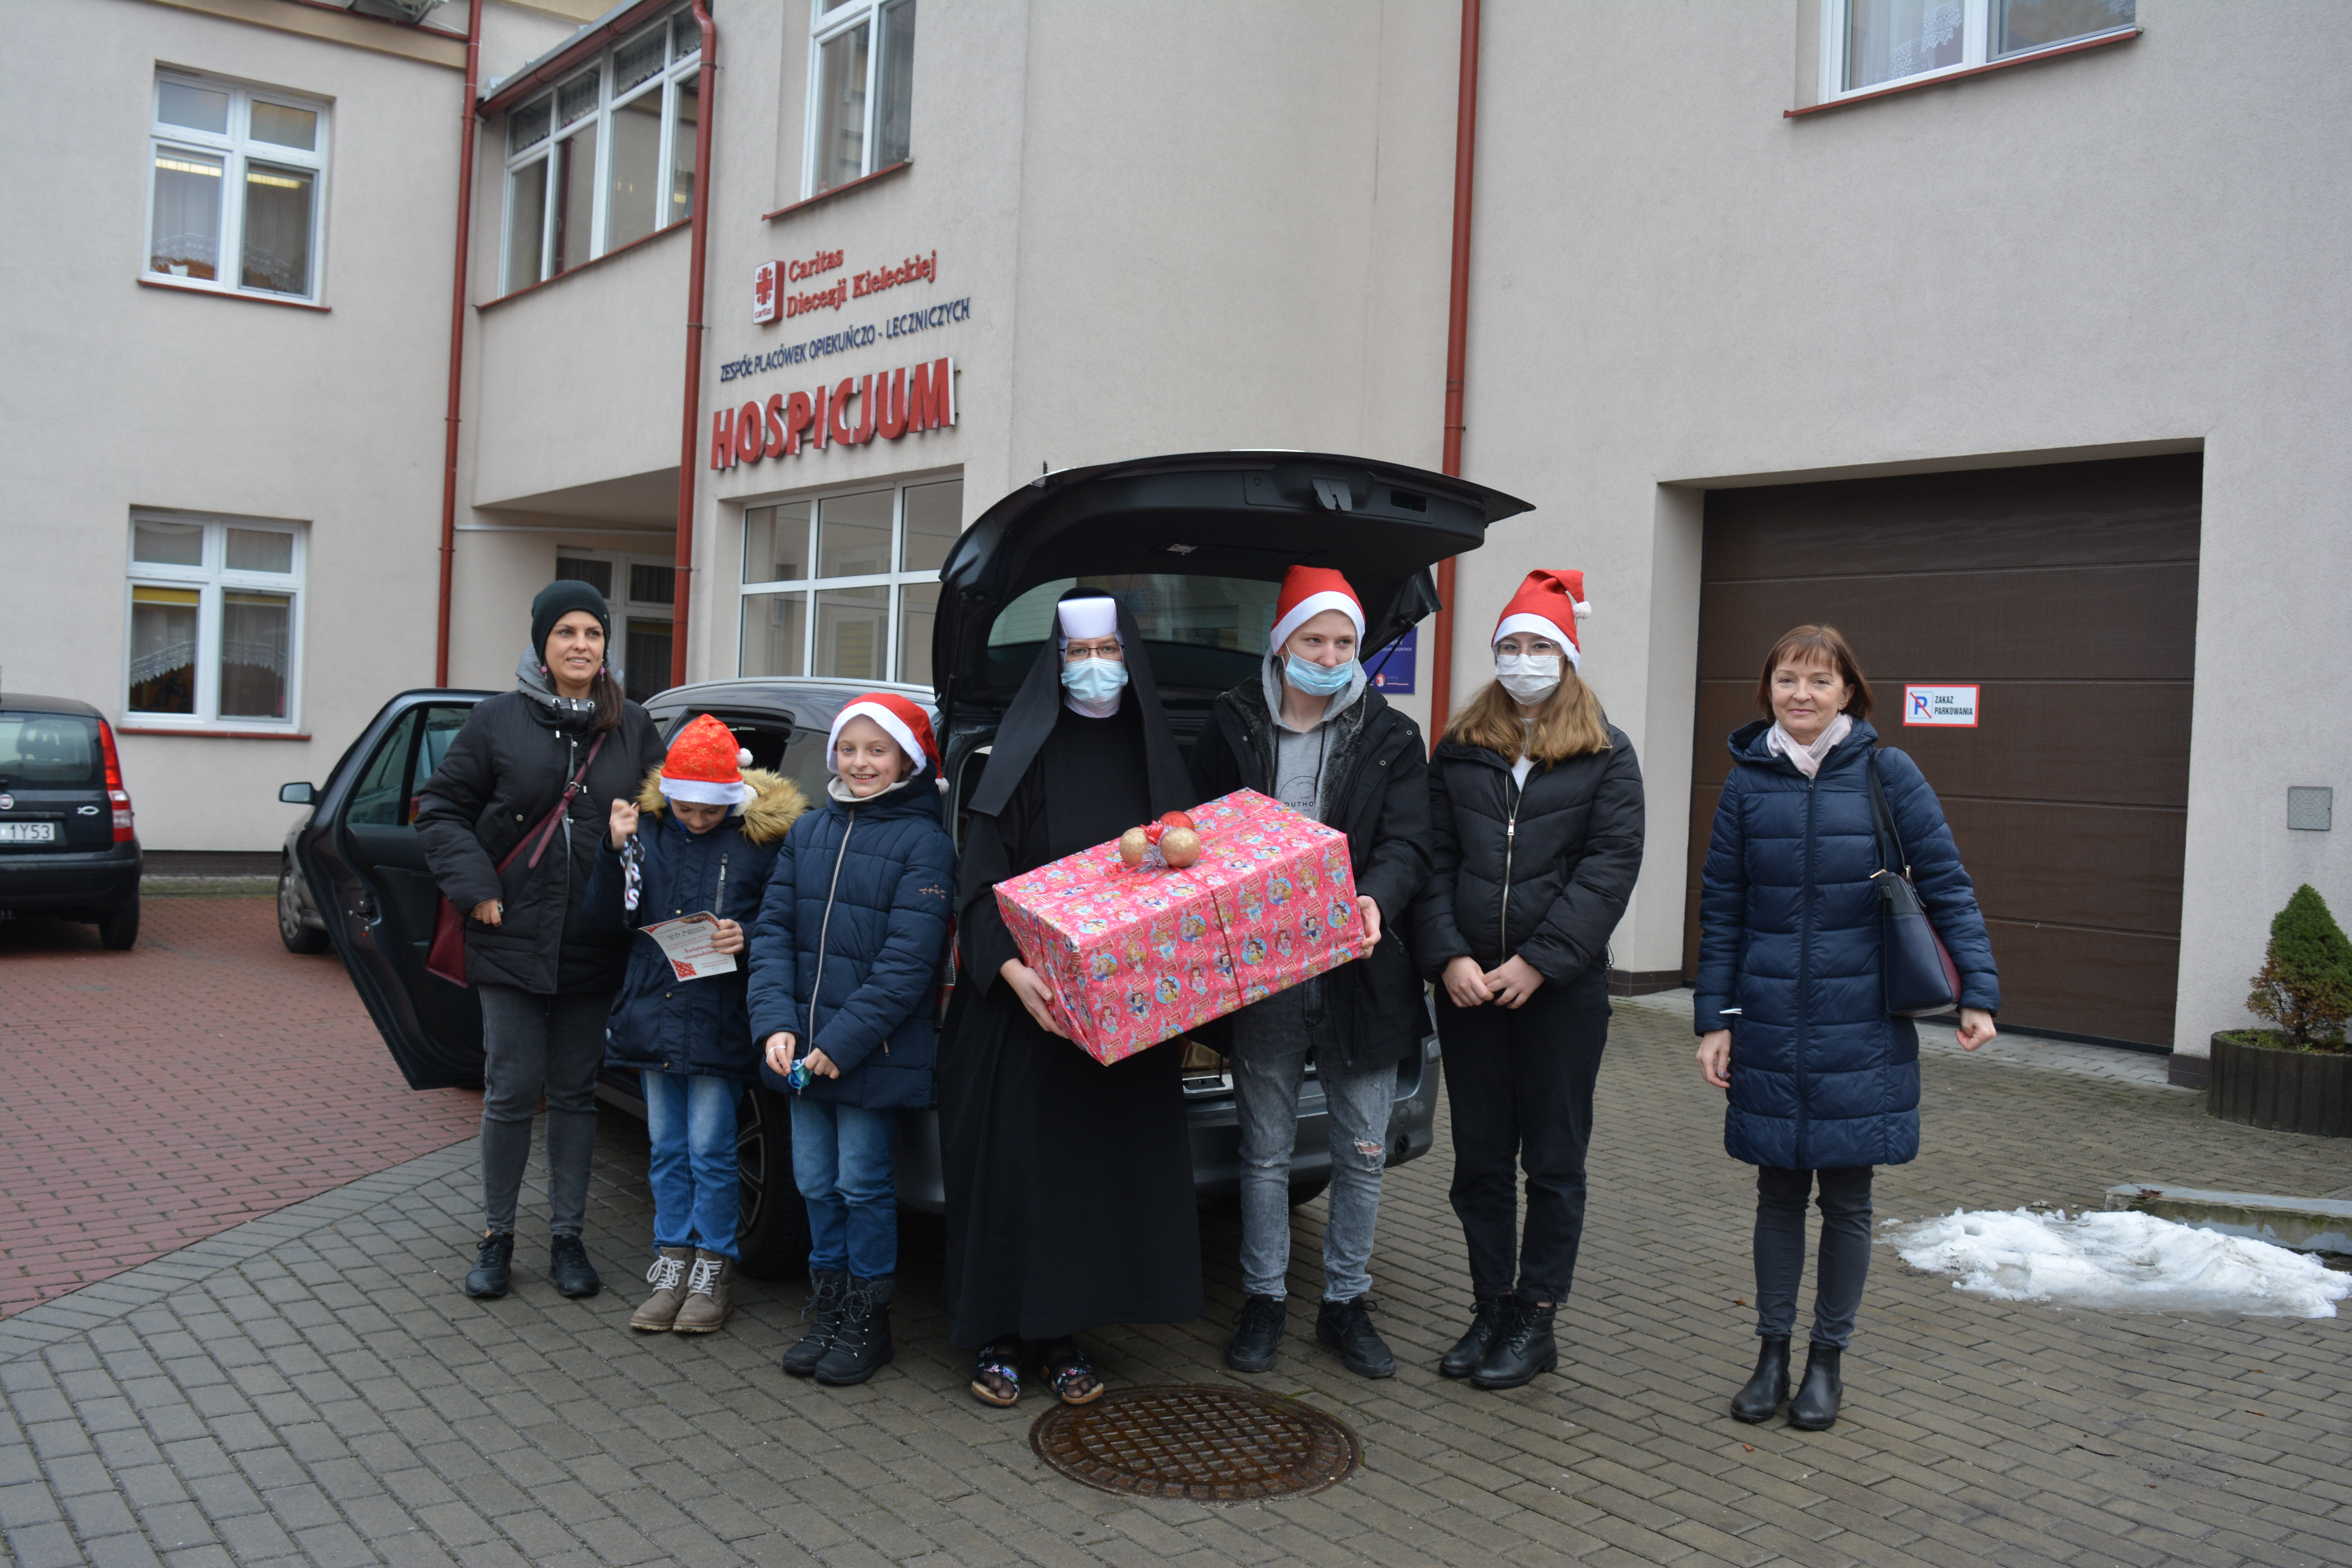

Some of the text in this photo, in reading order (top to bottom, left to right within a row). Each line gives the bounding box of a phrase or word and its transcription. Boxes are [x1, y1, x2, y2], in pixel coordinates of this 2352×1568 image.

[787, 250, 937, 318] Diecezji Kieleckiej
[789, 249, 844, 282] Caritas
[755, 307, 772, 318] caritas
[720, 354, 753, 382] ZESPÓŁ
[754, 343, 806, 373] PLACÓWEK
[809, 324, 875, 359] OPIEKUŃCZO
[886, 297, 971, 339] LECZNICZYCH
[710, 357, 956, 470] HOSPICJUM
[1934, 707, 1973, 715] PARKOWANIA
